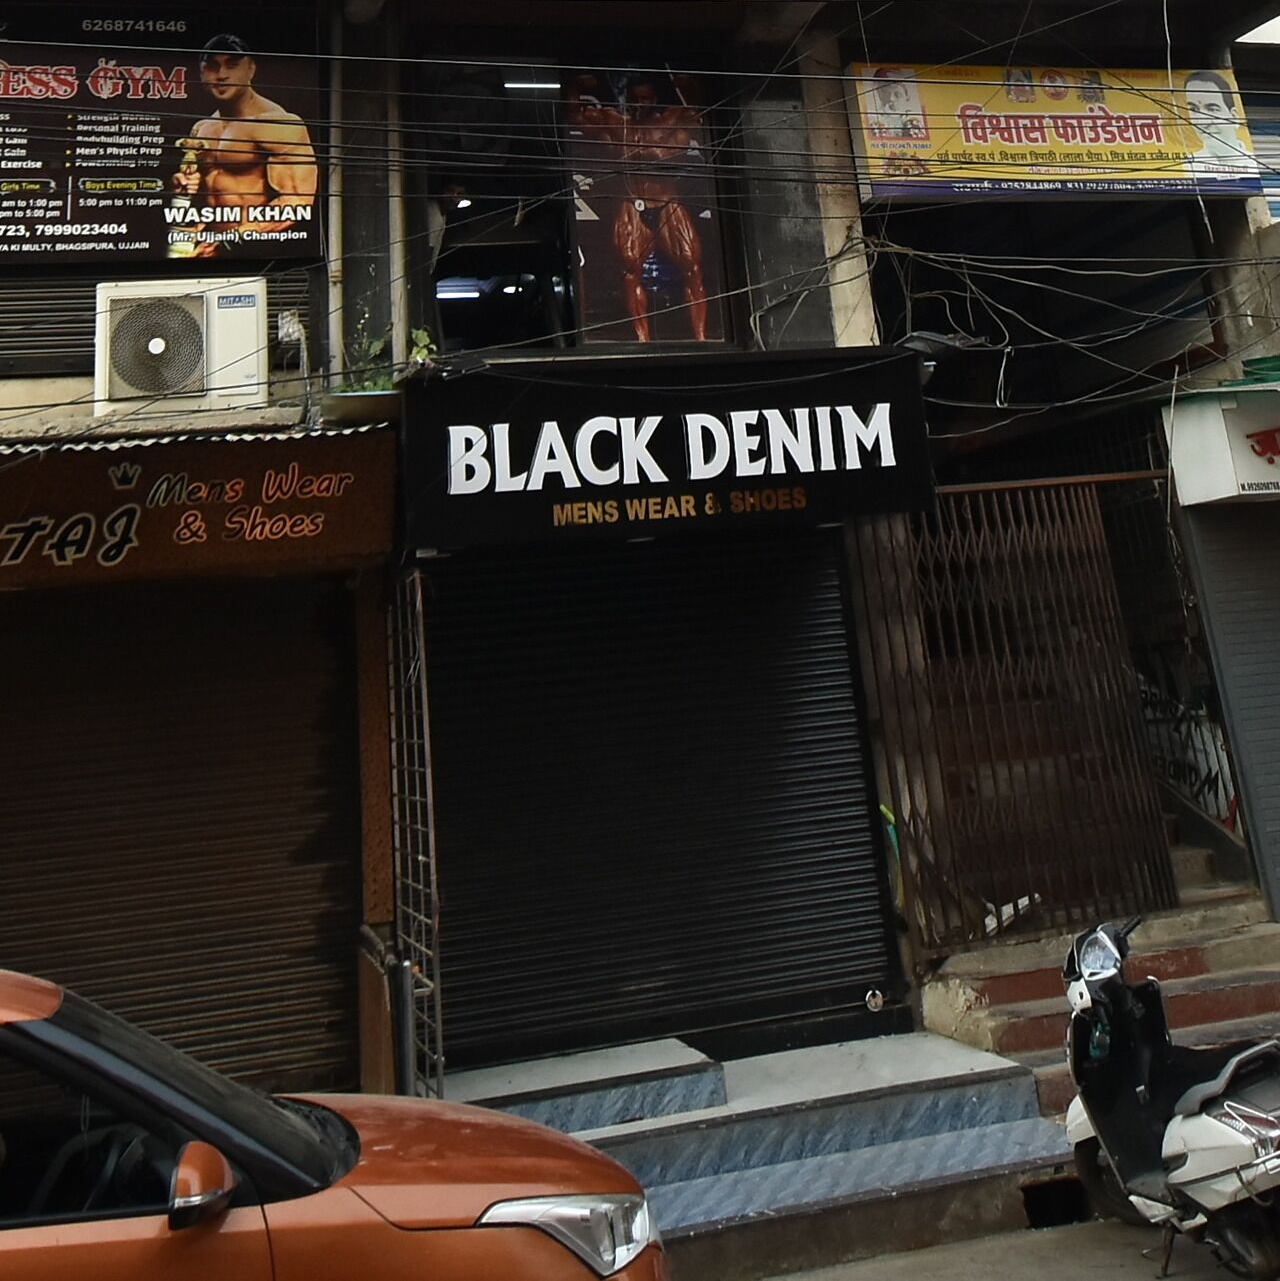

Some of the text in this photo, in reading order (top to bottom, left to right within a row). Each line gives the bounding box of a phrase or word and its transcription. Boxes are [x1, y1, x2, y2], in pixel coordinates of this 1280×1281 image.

[81, 19, 187, 32] 6268741646
[86, 57, 189, 99] GYM
[76, 123, 161, 133] Personal Training
[957, 104, 1164, 145] विश्वास फाउंडेशन
[142, 135, 165, 144] Prep
[3, 147, 27, 157] Gain
[75, 146, 163, 157] Men's Physic Prep
[0, 159, 43, 169] Exercise
[0, 182, 41, 191] Girls Time
[85, 181, 105, 191] Boys
[106, 181, 139, 191] Evening
[1, 200, 16, 208] am
[17, 199, 27, 208] to
[28, 198, 46, 207] 1:00
[47, 200, 63, 209] pm
[78, 197, 163, 208] 5:00 pm to 11:00 pm
[14, 209, 25, 218] to
[25, 208, 44, 218] 5:00
[44, 209, 60, 219] pm
[163, 205, 312, 224] WASIM KHAN
[34, 223, 128, 236] 7999023404
[243, 229, 308, 242] Champion
[10, 244, 21, 252] KI
[21, 243, 54, 252] MULTY,
[55, 242, 116, 252] BHAGSIPURA,
[118, 241, 150, 250] UJJAIN
[447, 402, 897, 496] BLACK DENIM
[146, 470, 246, 509] Mens
[261, 462, 355, 502] Wear
[553, 487, 807, 527] MENS WEAR & SHOES
[172, 504, 326, 545] & Shoes
